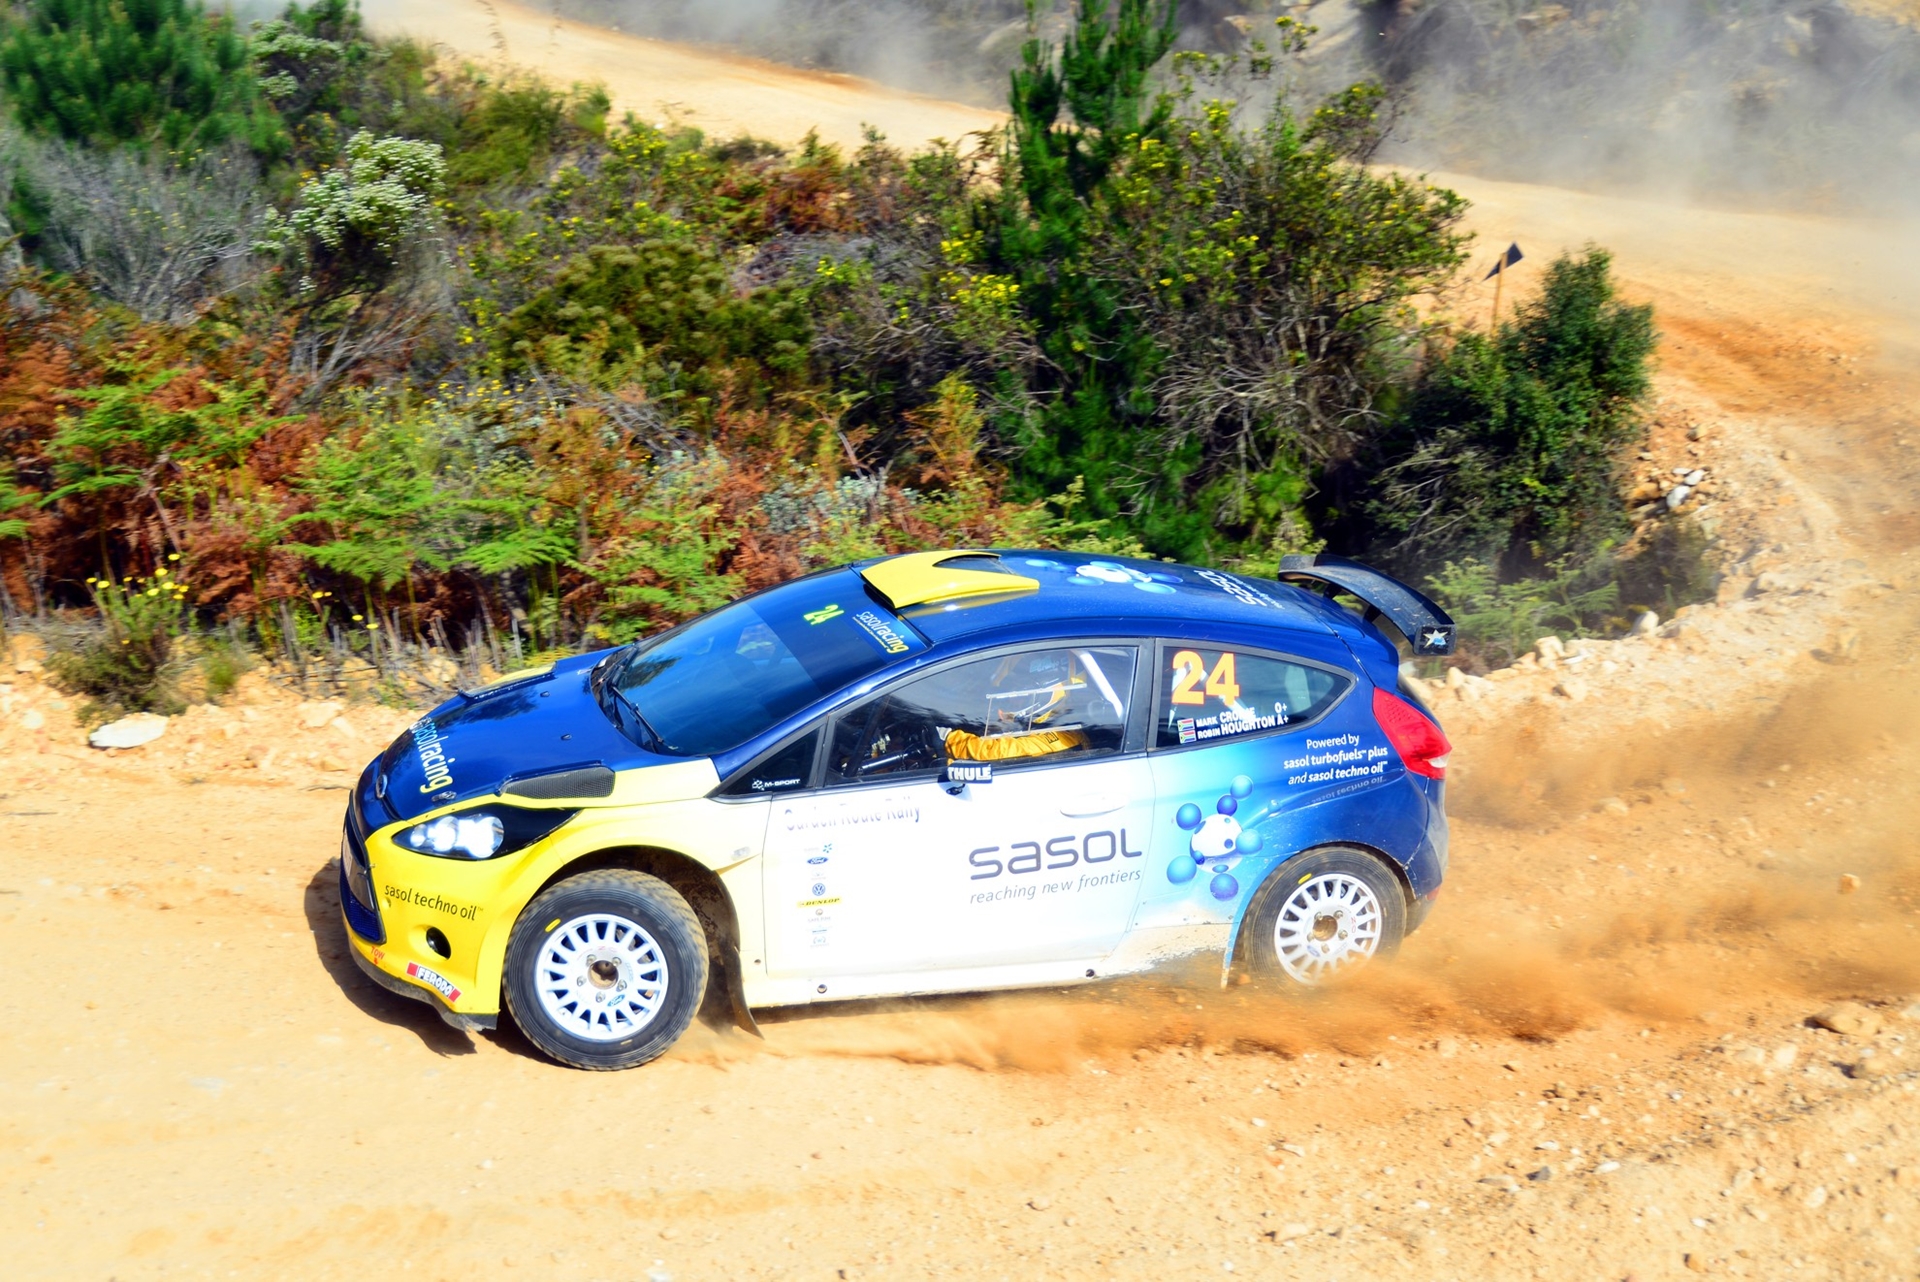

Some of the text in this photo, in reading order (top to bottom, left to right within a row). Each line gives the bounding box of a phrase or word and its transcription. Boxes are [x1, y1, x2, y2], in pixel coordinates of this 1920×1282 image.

[803, 604, 844, 625] 24
[1171, 650, 1240, 706] 24
[1196, 716, 1218, 727] MARK
[1219, 707, 1255, 723] CROE
[1197, 728, 1221, 739] ROBIN
[1220, 715, 1276, 735] HOUGHTON
[1306, 733, 1360, 749] Powered by
[1283, 755, 1309, 769] sasol
[1368, 746, 1388, 761] plus
[948, 764, 992, 781] THULE
[1288, 772, 1307, 785] and
[1308, 768, 1334, 783] sasol
[1335, 765, 1369, 779] techno
[764, 779, 801, 788] M-SPORT
[970, 869, 1141, 904] reaching new frontiers
[385, 885, 412, 903] sasol
[414, 892, 458, 915] techno
[806, 898, 840, 906] DUNLOP
[371, 945, 385, 959] TOW
[417, 966, 453, 997] FERODO
